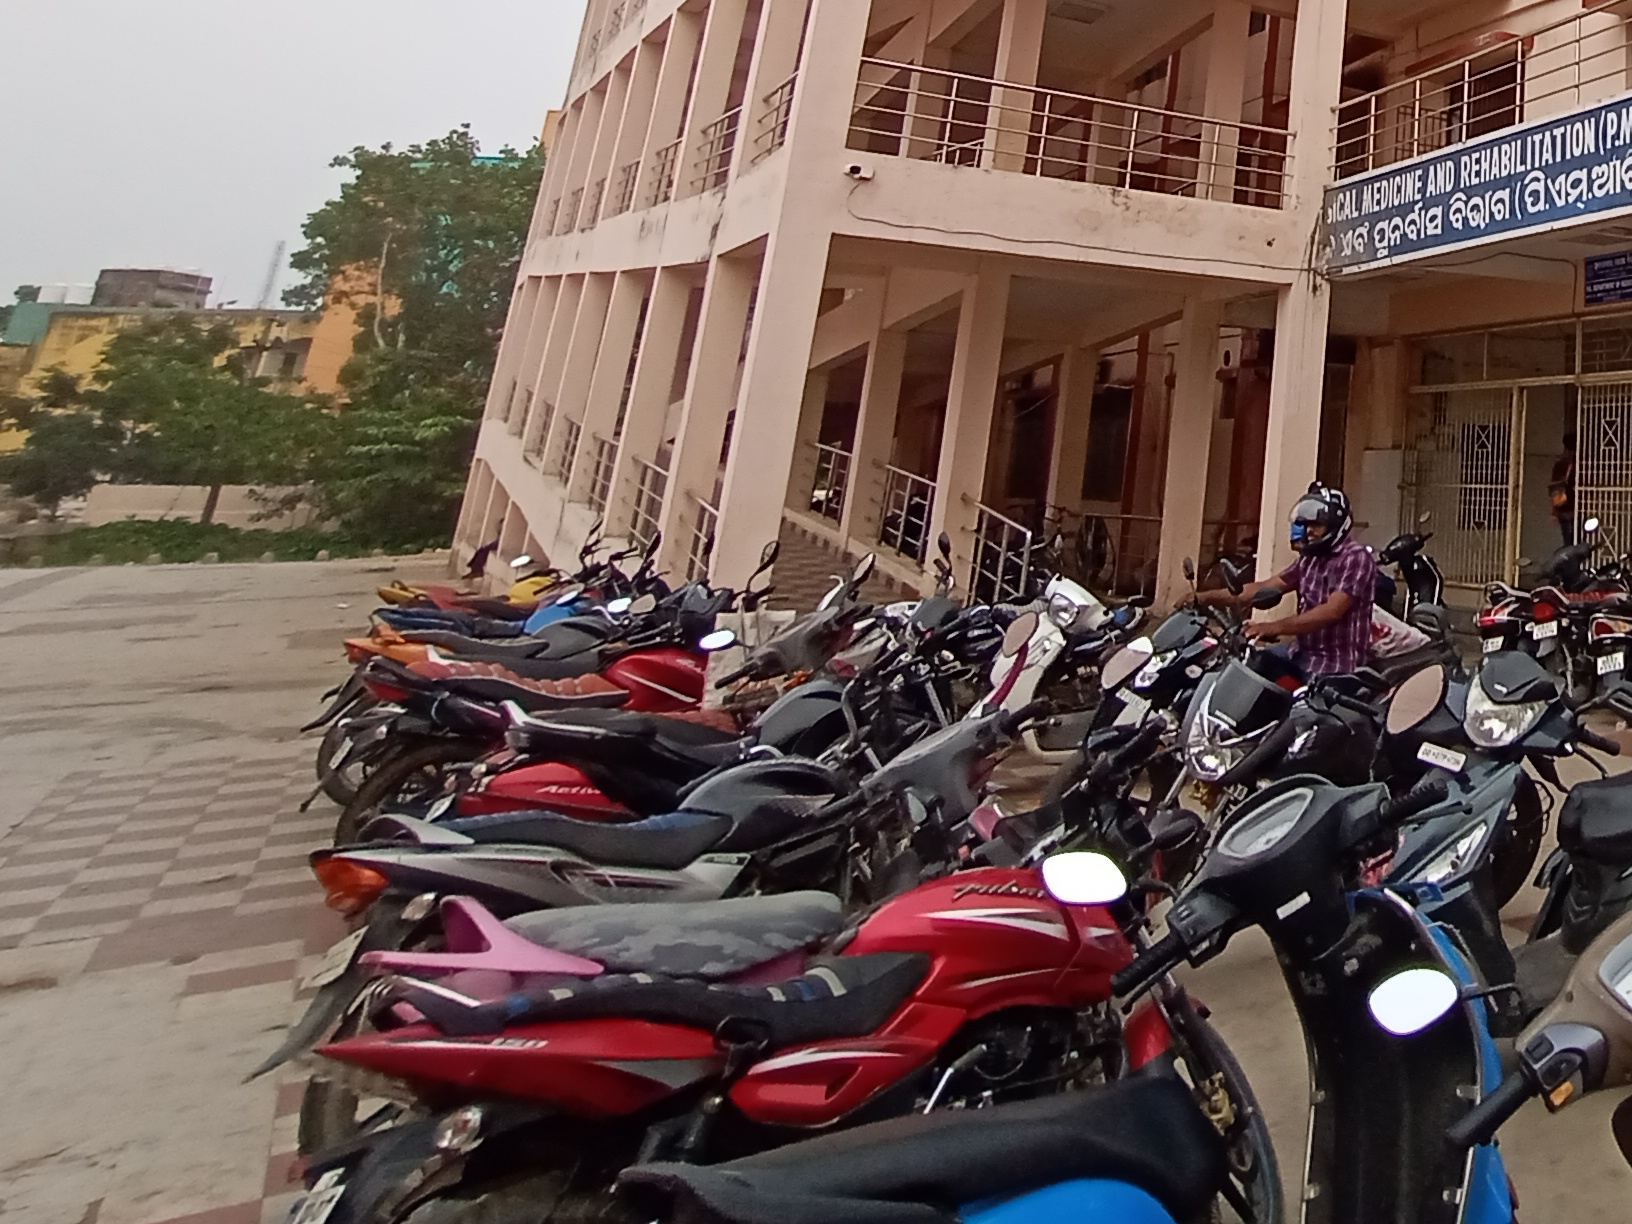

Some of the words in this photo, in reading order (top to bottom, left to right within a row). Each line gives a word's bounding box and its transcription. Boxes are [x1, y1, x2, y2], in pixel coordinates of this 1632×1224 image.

[1360, 168, 1424, 216] MEDICINE
[1426, 159, 1455, 199] AND
[1459, 117, 1596, 188] REHABILITATION
